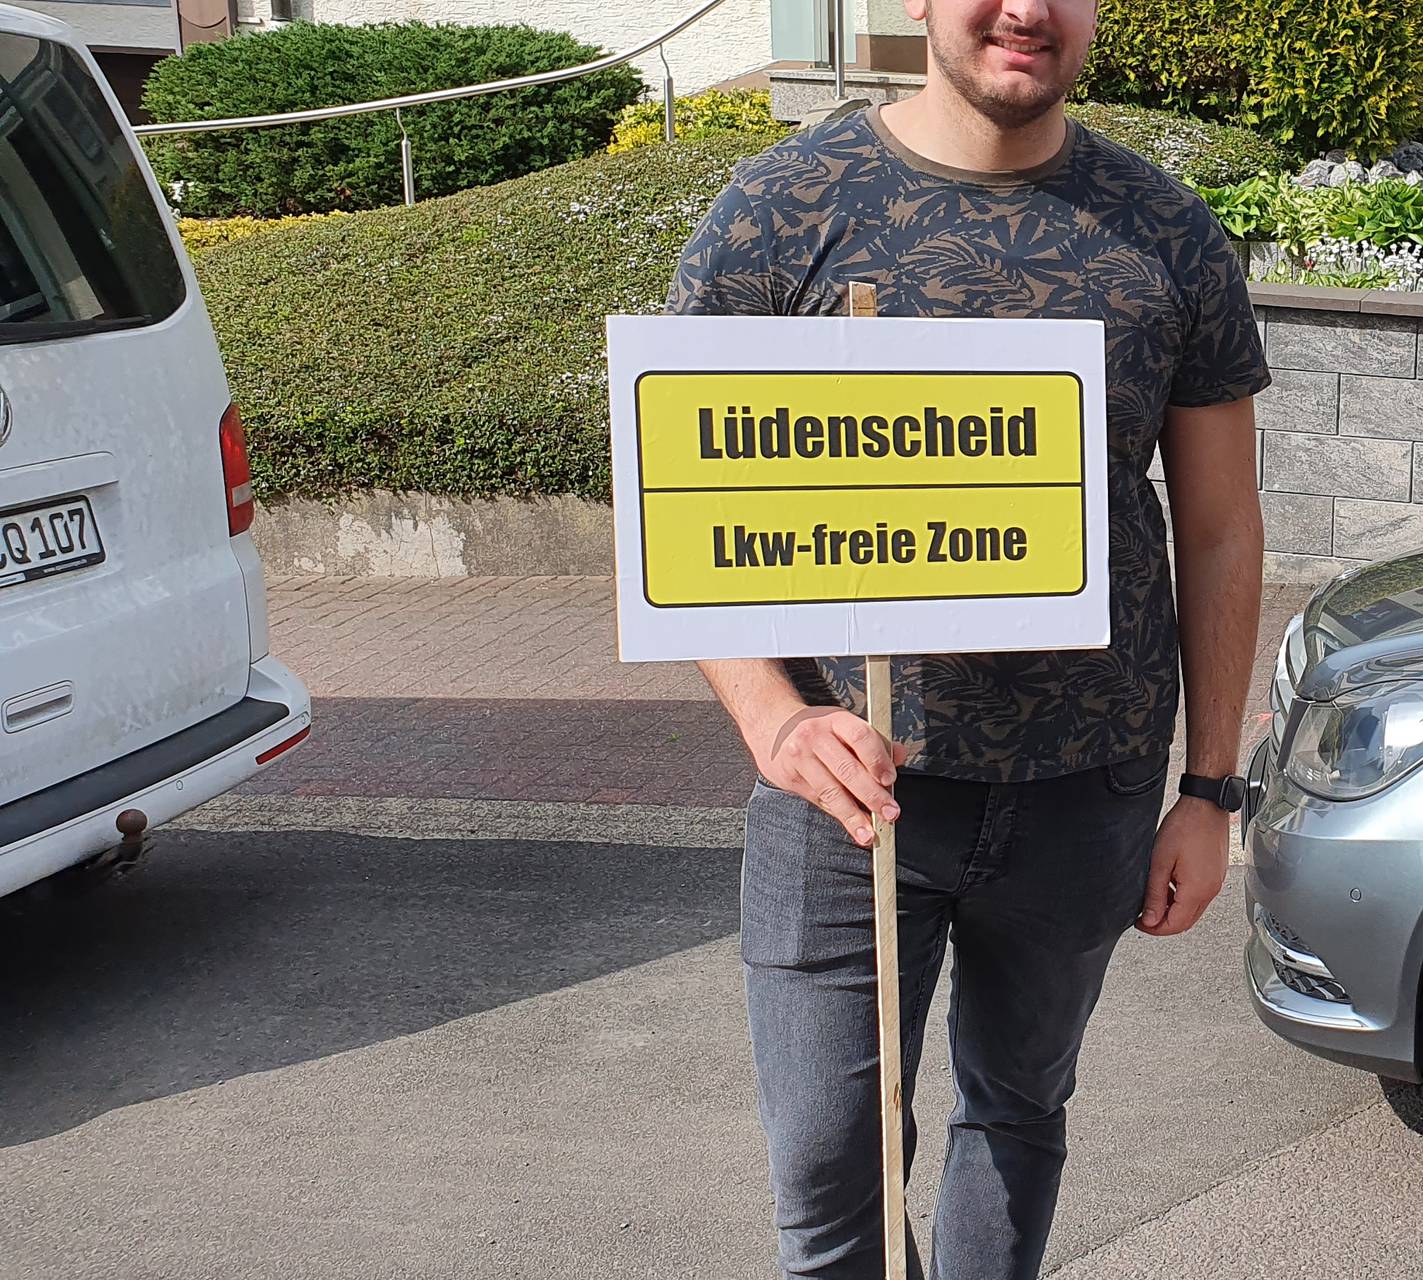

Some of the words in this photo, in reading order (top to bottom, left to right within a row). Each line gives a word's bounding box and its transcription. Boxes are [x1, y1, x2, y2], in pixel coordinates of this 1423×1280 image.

[698, 405, 1037, 460] Lüdenscheid
[712, 523, 916, 568] Lkw-freie
[926, 521, 1027, 563] Zone
